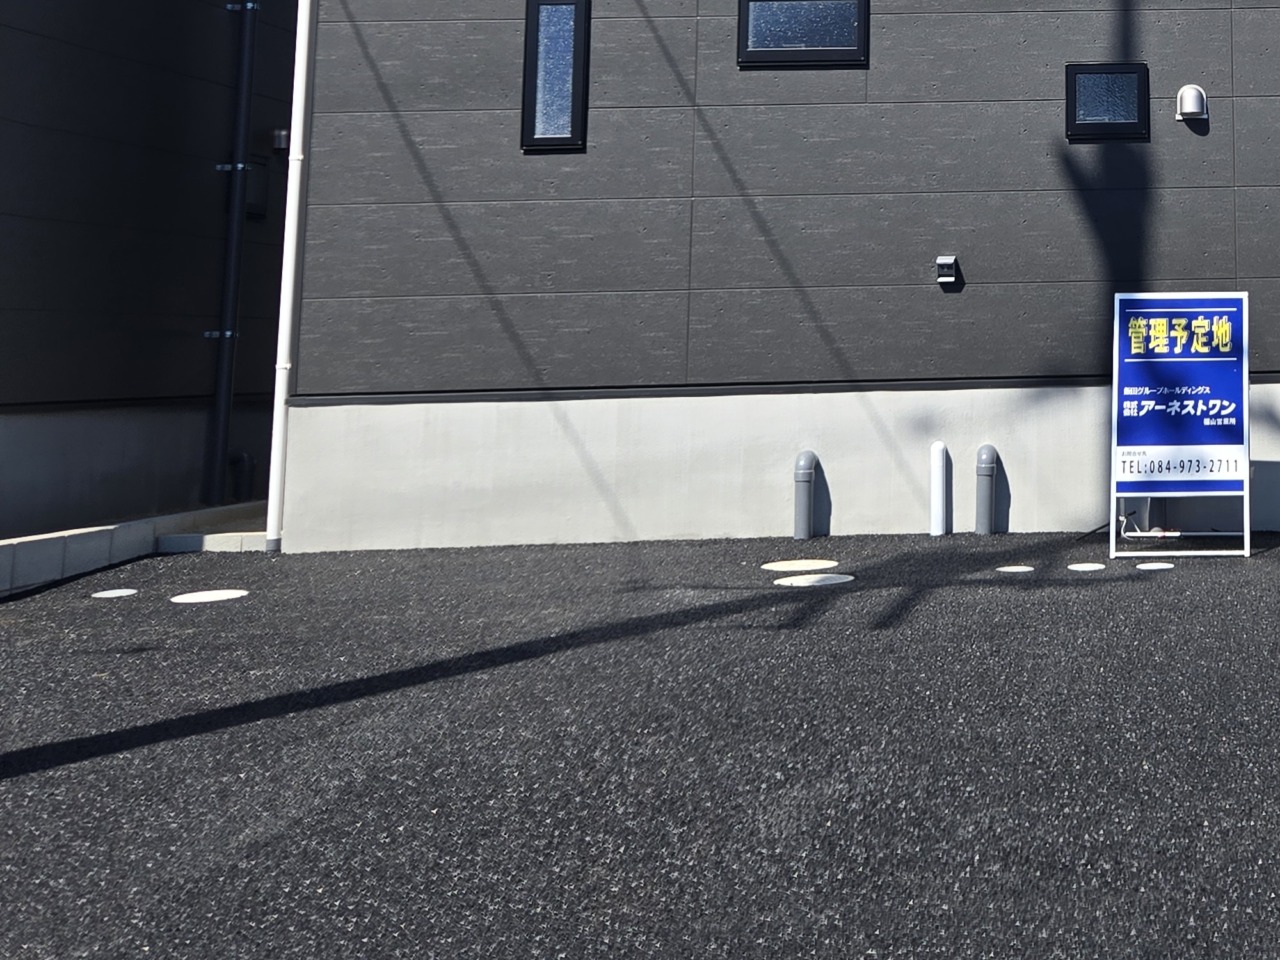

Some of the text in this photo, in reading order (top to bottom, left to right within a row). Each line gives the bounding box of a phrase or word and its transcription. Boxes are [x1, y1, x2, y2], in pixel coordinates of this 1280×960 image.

[1128, 315, 1233, 354] 管理予定地
[1121, 459, 1238, 474] TEL:084-973-2711
